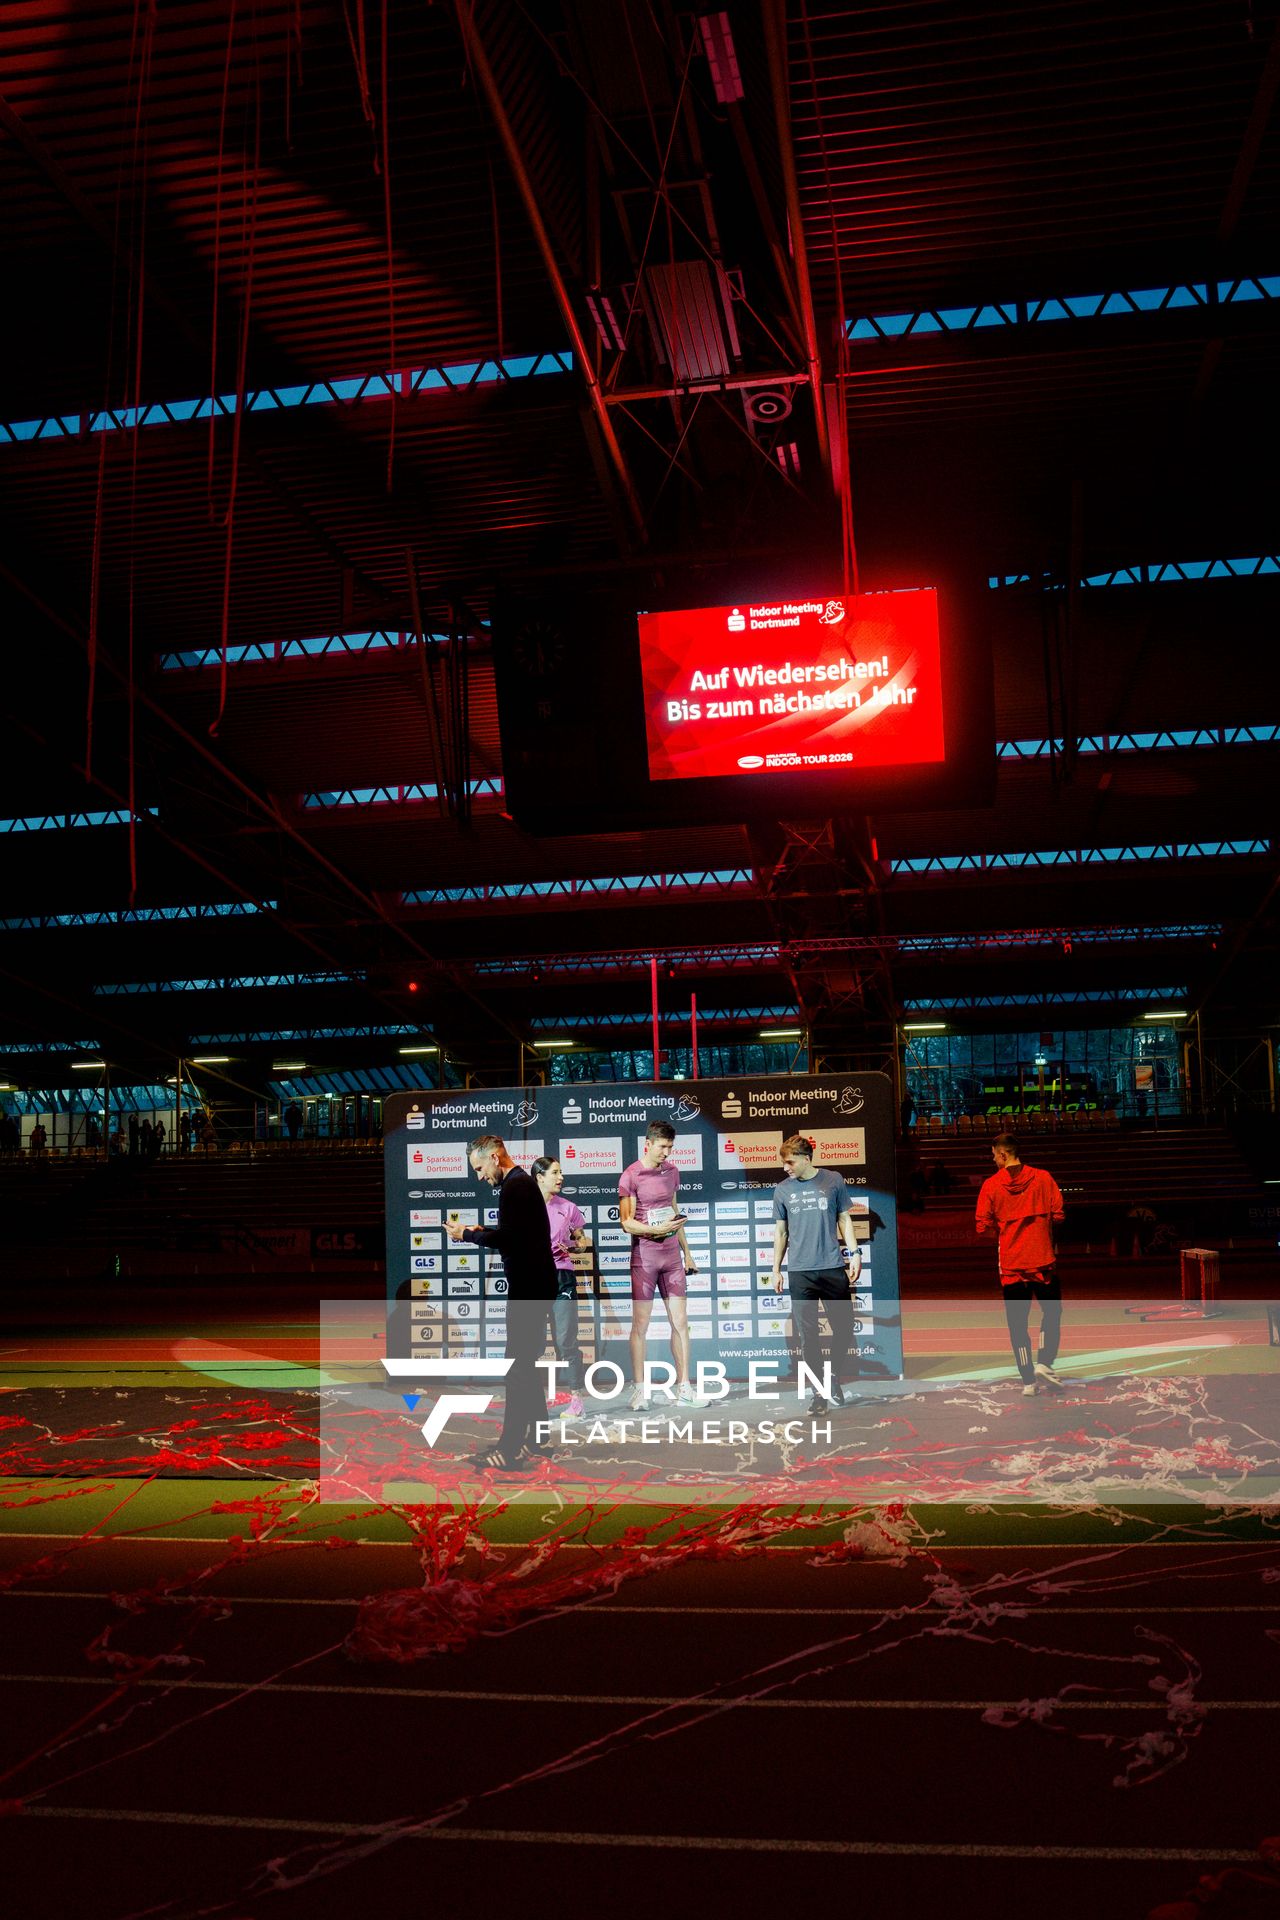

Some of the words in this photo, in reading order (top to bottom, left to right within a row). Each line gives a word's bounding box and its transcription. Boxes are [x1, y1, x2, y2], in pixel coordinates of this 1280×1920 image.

[750, 606, 781, 617] Indoor
[783, 602, 823, 614] Meeting
[751, 616, 800, 629] Dortmund
[690, 667, 729, 691] Auf
[733, 656, 889, 687] Wiedersehen!
[667, 699, 701, 721] Bis
[706, 700, 753, 718] zum
[760, 690, 861, 714] nächsten
[766, 756, 801, 767] INDOOR
[803, 754, 827, 764] TOUR
[749, 1091, 787, 1103] Indoor
[789, 1088, 837, 1101] Meeting
[431, 1104, 467, 1115] Indoor
[469, 1101, 514, 1114] Meeting
[589, 1097, 625, 1109] Indoor
[628, 1095, 675, 1109] Meeting
[589, 1110, 647, 1123] Dortmund
[749, 1104, 809, 1117] Dortmund
[431, 1117, 487, 1129] Dortmund
[738, 1145, 777, 1154] Sparkasse
[820, 1141, 859, 1151] Sparkasse
[426, 1155, 462, 1164] Sparkasse
[579, 1150, 617, 1160] Sparkasse
[739, 1154, 777, 1163] Dortmund
[820, 1151, 859, 1160] Dortmund
[426, 1164, 462, 1172] Dortmund
[579, 1160, 617, 1168] Dortmund
[415, 1258, 435, 1267] GLS
[723, 1322, 744, 1332] GLS
